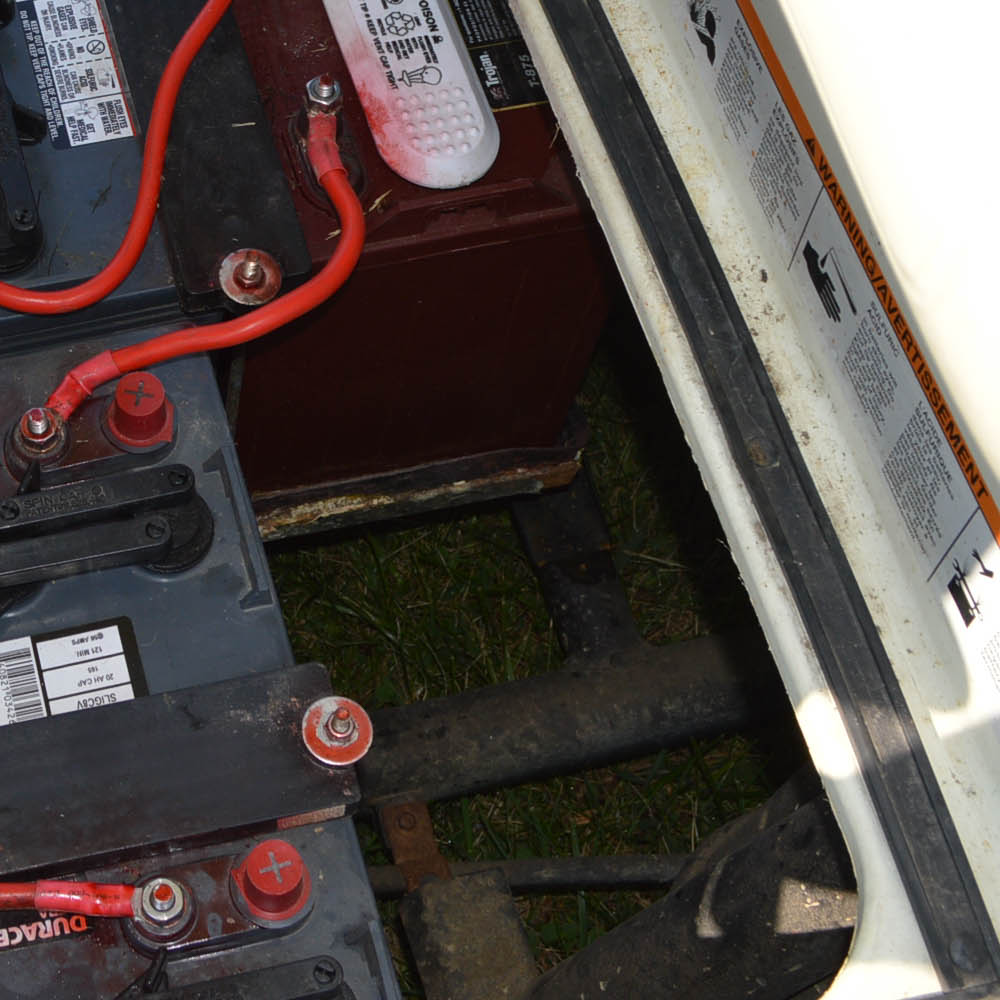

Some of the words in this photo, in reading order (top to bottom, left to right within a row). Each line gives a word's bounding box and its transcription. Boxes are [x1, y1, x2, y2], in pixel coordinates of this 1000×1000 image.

[19, 10, 27, 19] DO
[22, 19, 30, 31] NOT
[30, 20, 39, 34] KEEP
[33, 34, 42, 46] OUT
[27, 42, 37, 58] KEEP
[31, 58, 41, 72] VENT
[39, 56, 48, 66] THE
[42, 67, 53, 87] REACH
[480, 54, 499, 87] Trojan
[35, 73, 45, 89] CAPS
[39, 89, 49, 106] TIGHT
[47, 88, 55, 96] OF
[43, 106, 53, 120] AND
[49, 96, 63, 128] CHILDREN.
[97, 102, 106, 115] WITH
[66, 115, 76, 129] HELP
[105, 100, 120, 135] IMMEDIATELY
[118, 115, 128, 128] EYES
[47, 121, 58, 141] LEVEL.
[76, 118, 88, 142] MEDICAL
[85, 123, 95, 133] GET
[818, 155, 987, 499] WARNING/AVERTISSEMENT
[866, 306, 882, 337] ACID
[76, 677, 92, 686] CAP
[92, 675, 104, 683] AH
